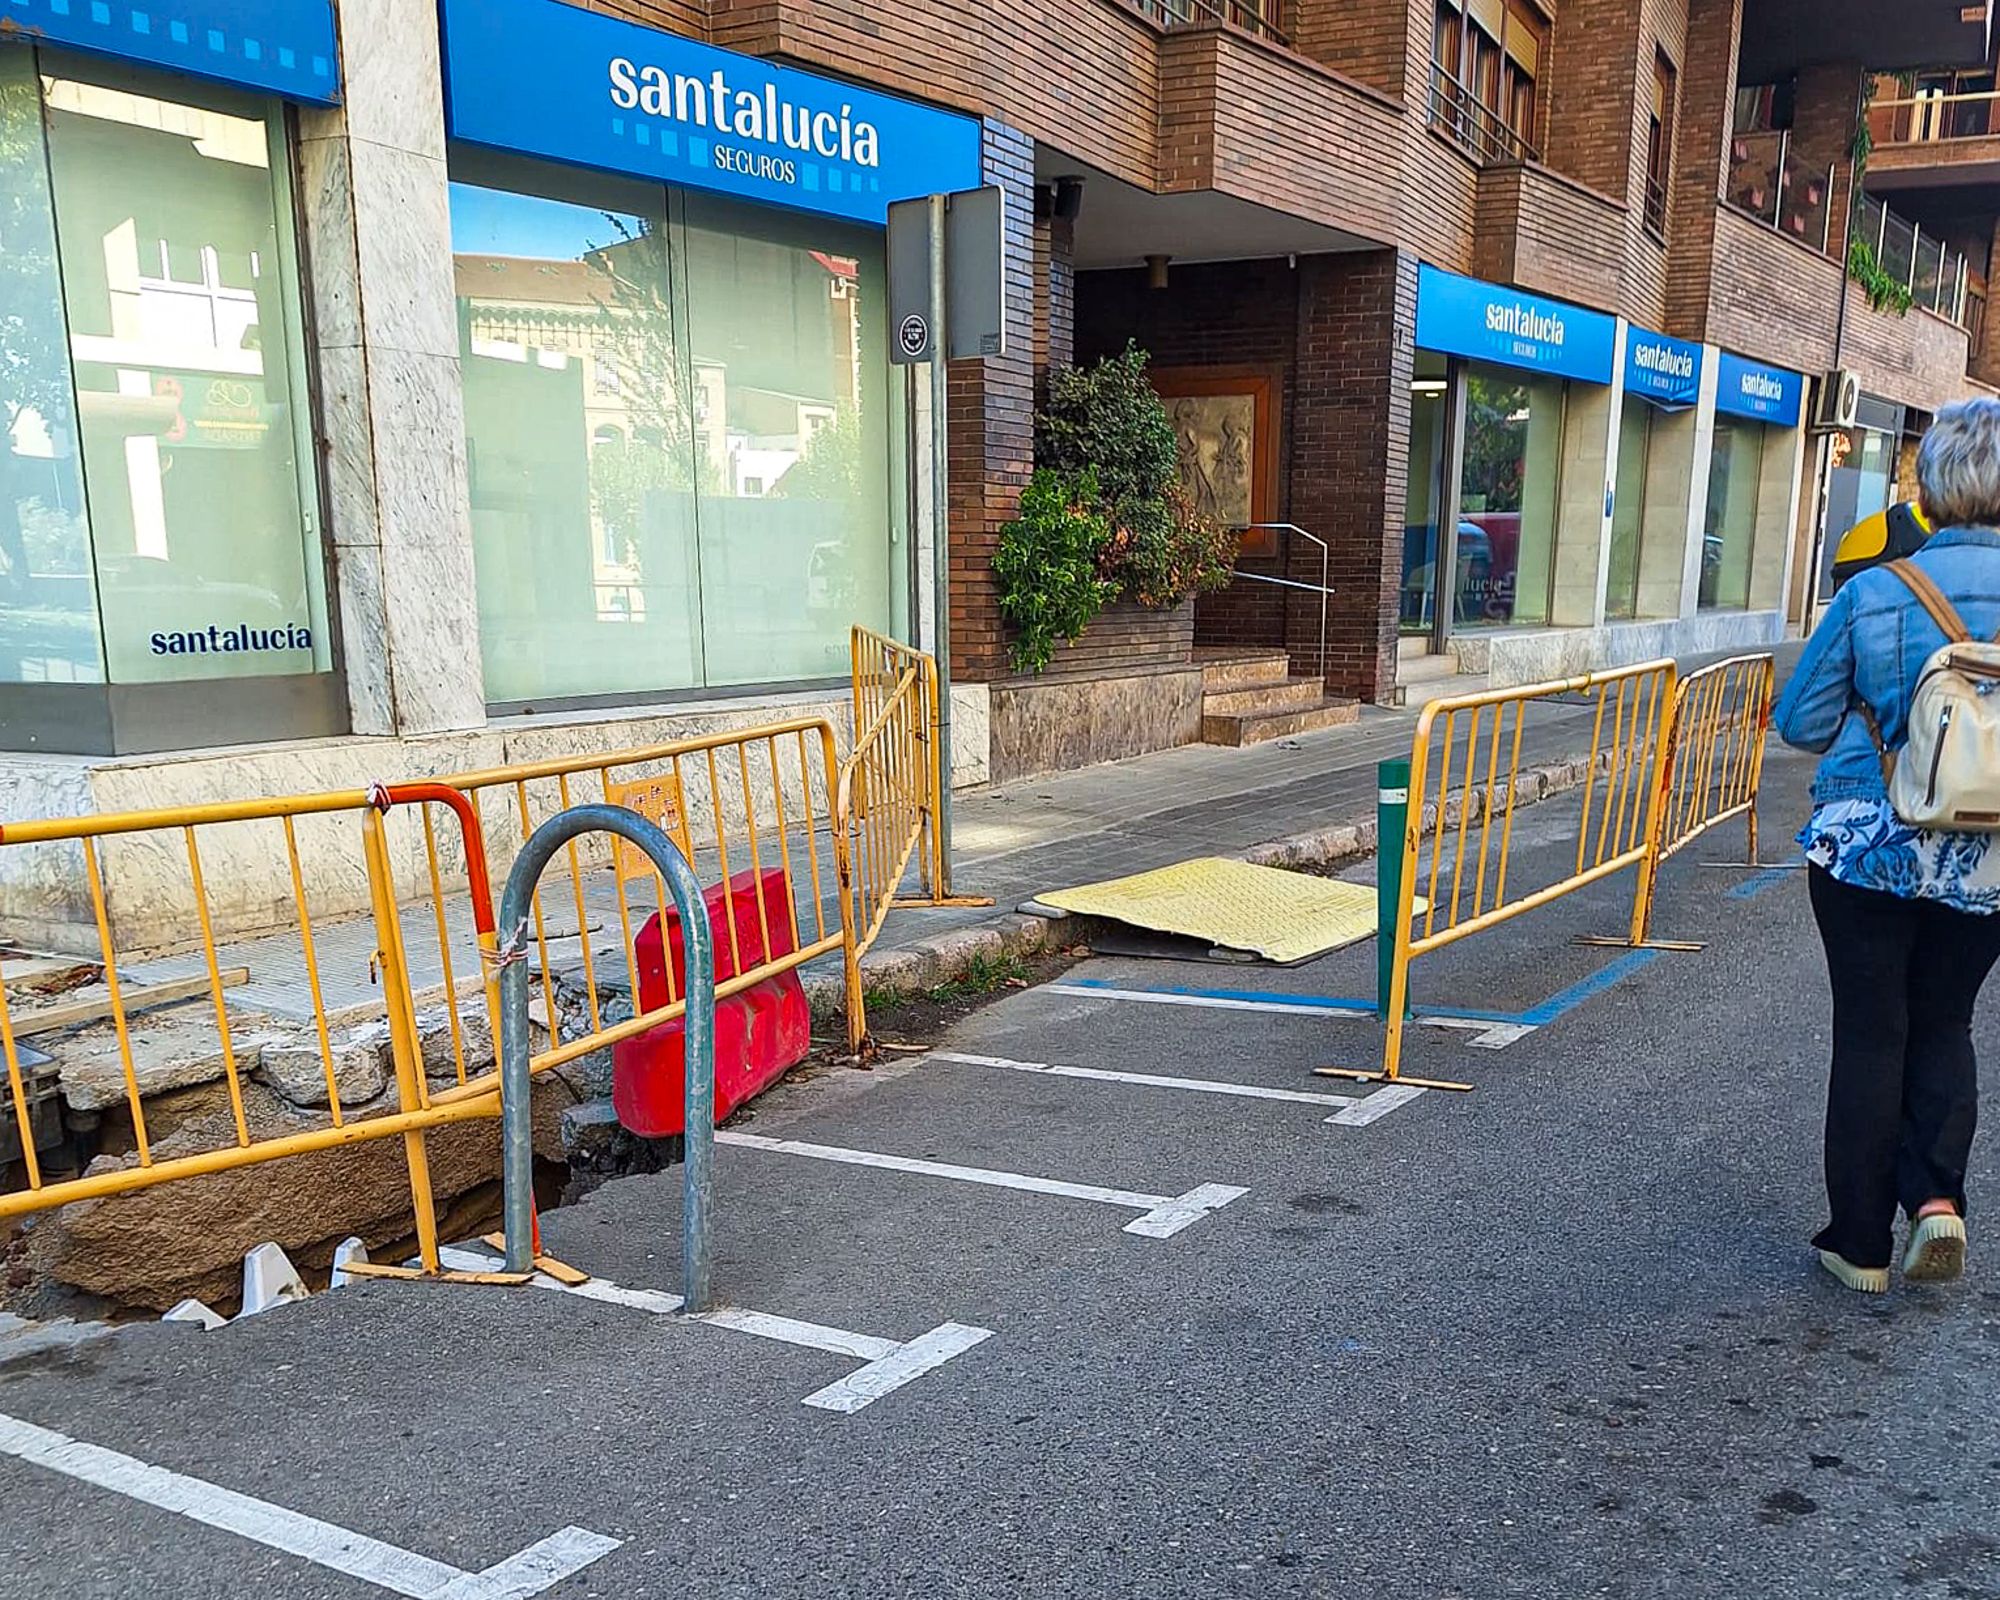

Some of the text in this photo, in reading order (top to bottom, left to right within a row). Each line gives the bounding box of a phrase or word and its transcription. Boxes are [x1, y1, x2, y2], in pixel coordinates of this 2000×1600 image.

[609, 57, 879, 167] santalucía
[714, 144, 796, 184] SEGUROS
[1486, 302, 1564, 345] santalucía
[1635, 343, 1692, 377] santalucía
[151, 622, 312, 655] santalucía
